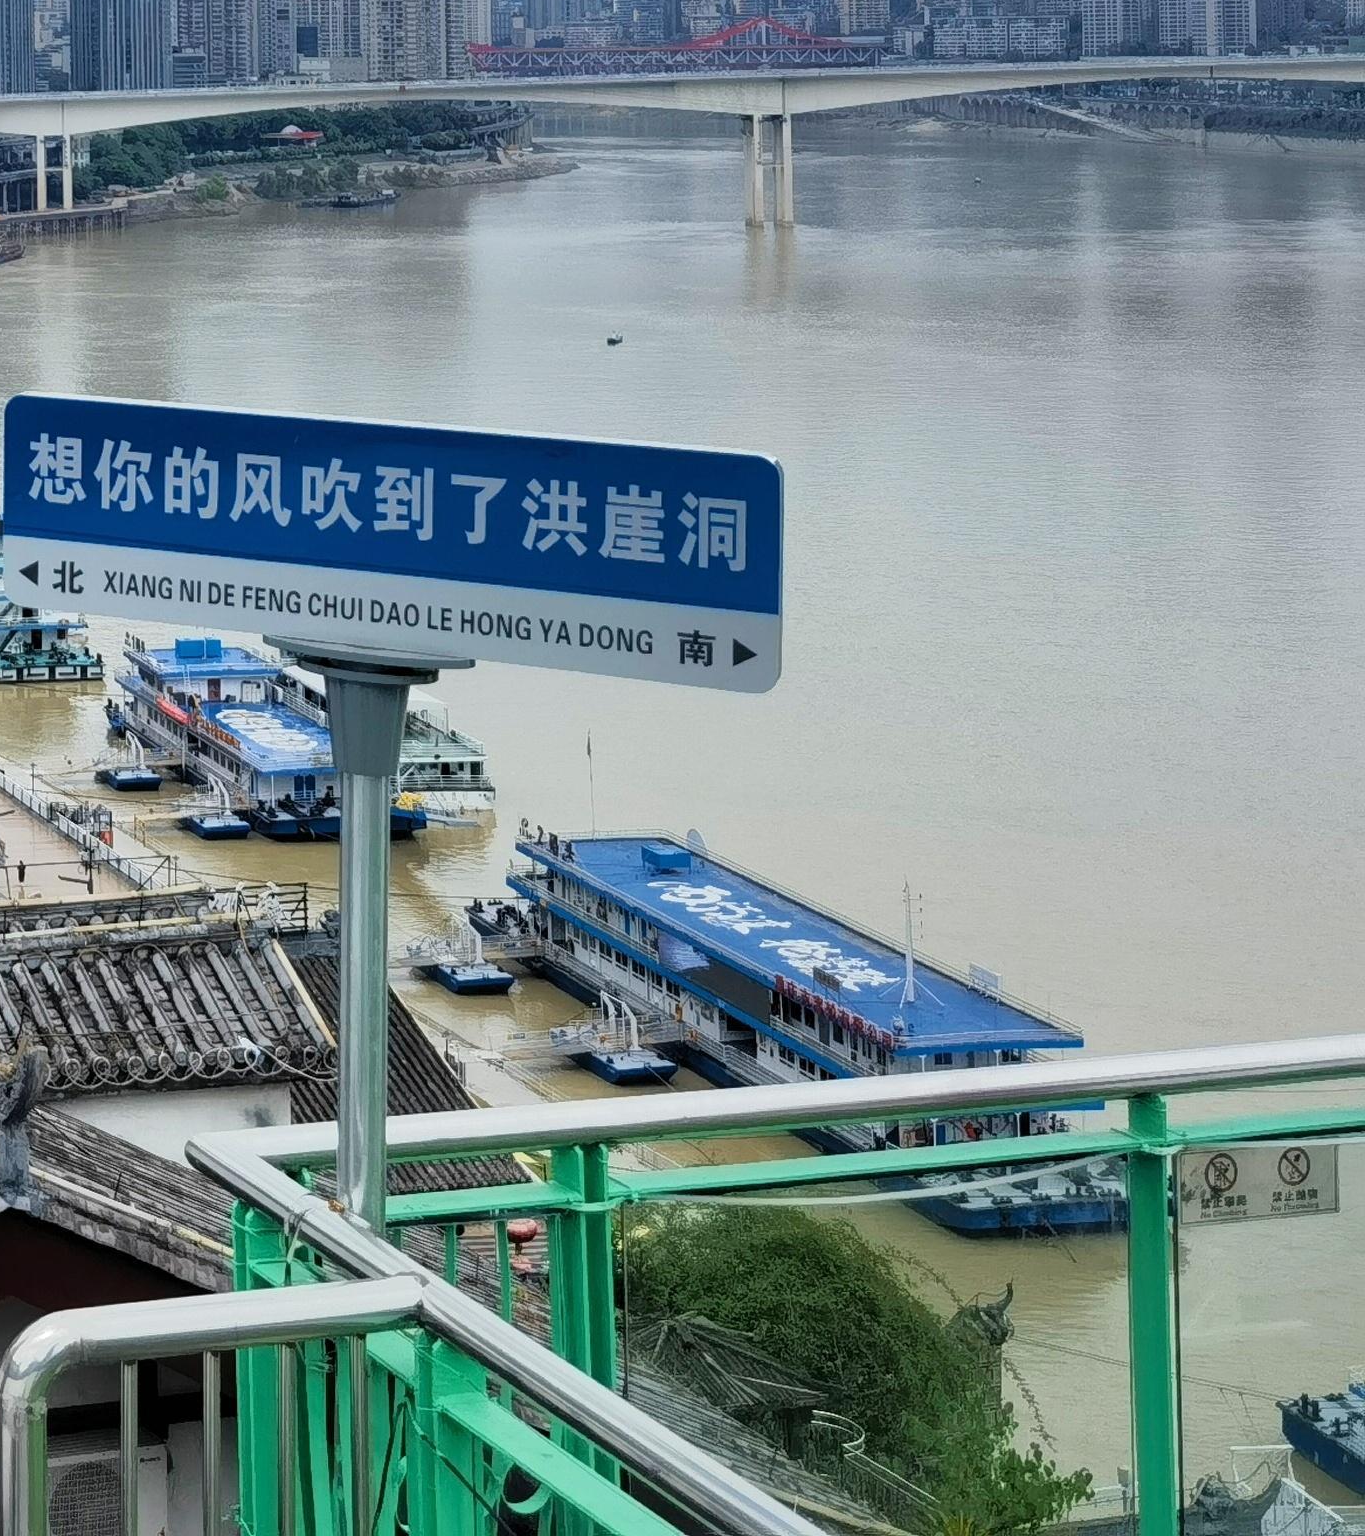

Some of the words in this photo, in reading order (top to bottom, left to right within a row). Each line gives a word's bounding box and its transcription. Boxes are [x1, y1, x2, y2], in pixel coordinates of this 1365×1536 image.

[29, 432, 749, 572] 想你的风吹到了洪崖洞
[53, 561, 85, 594] 北
[103, 569, 173, 600] XIANG
[179, 579, 202, 603] NI
[208, 581, 235, 607] DE
[242, 585, 302, 614] FENG
[308, 592, 363, 621] CHUI
[370, 599, 420, 627] DAO
[427, 604, 453, 632] LE
[460, 609, 532, 641] HONG
[539, 618, 572, 646] YA
[578, 623, 653, 655] DONG
[677, 629, 716, 668] 南
